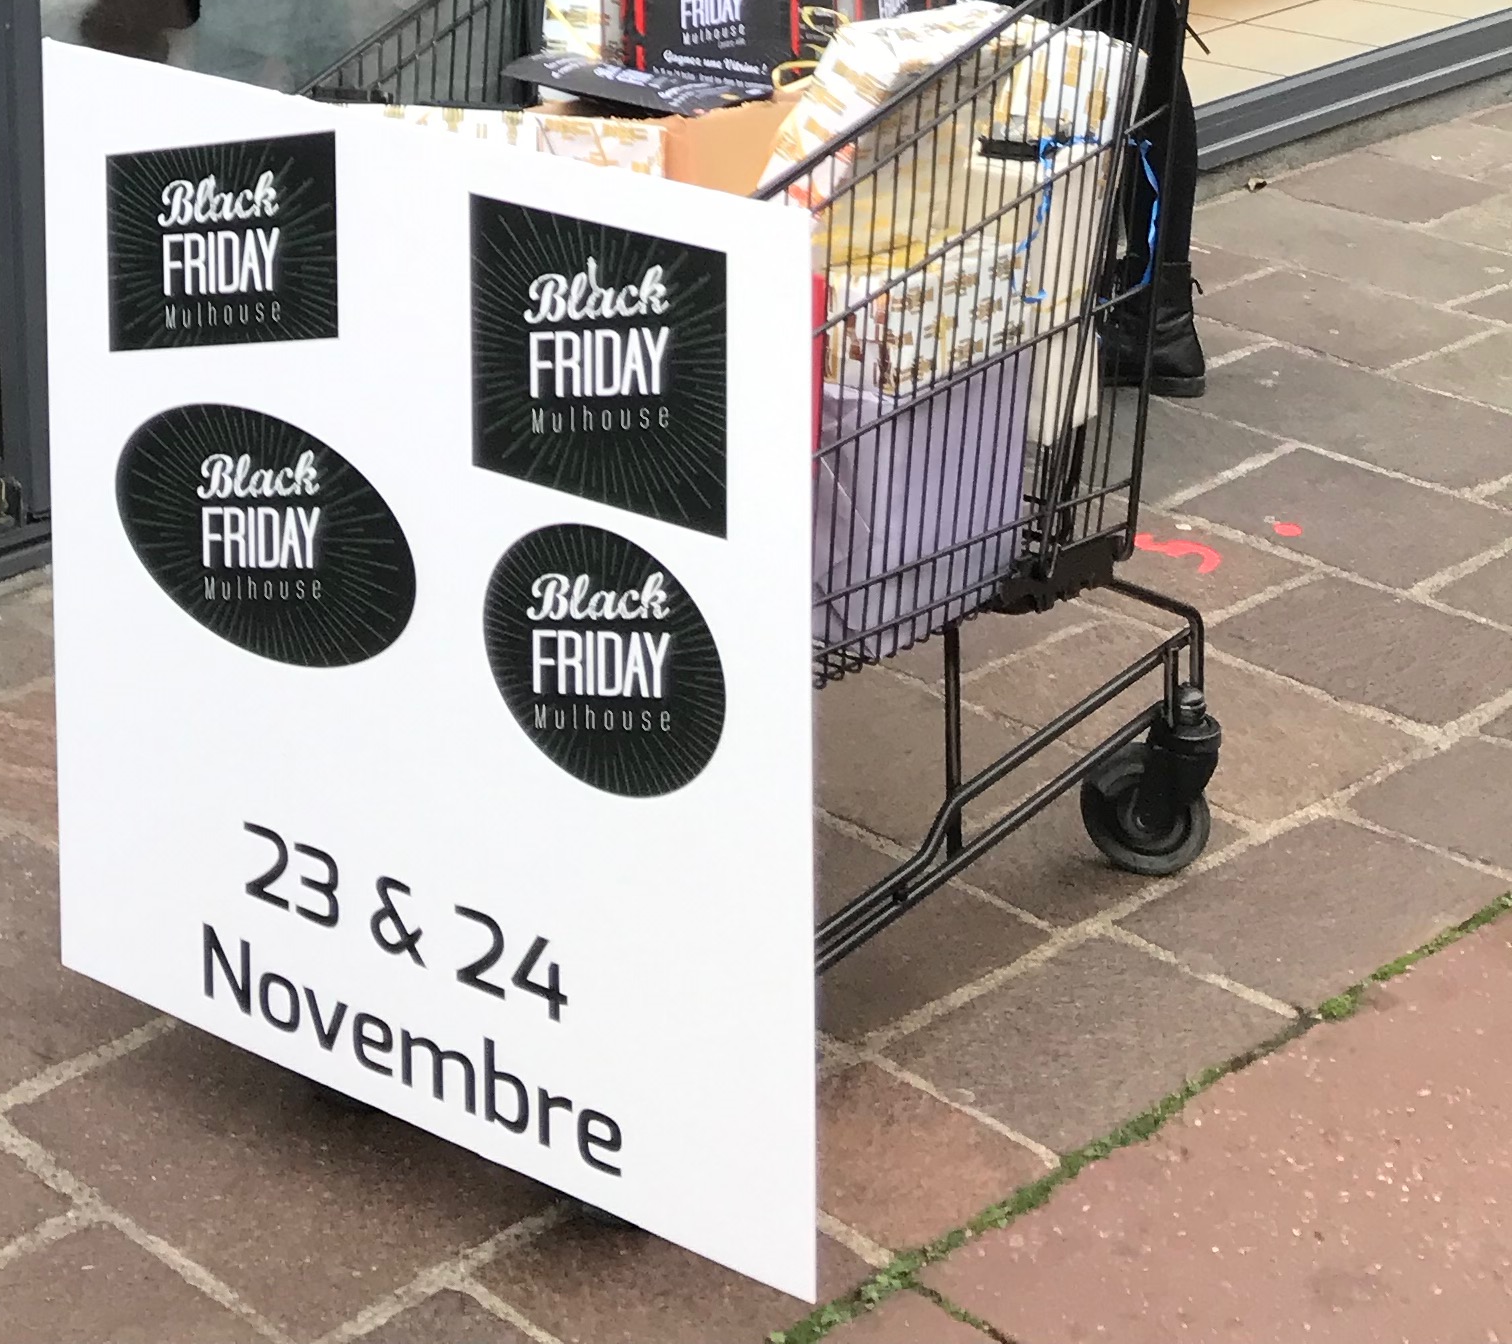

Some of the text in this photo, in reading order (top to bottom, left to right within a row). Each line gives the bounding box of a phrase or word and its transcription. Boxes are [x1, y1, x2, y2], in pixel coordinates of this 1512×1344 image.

[157, 171, 279, 226] Black
[162, 228, 280, 296] FRIDAY
[523, 259, 670, 324] Black
[165, 299, 282, 330] Mulhouse
[529, 327, 670, 398] FRIDAY
[531, 405, 670, 434] Mulhouse
[196, 450, 320, 500] Black
[201, 506, 321, 569] FRIDAY
[204, 574, 323, 601] Mulhouse
[526, 572, 671, 622] Black
[531, 630, 671, 699] FRIDAY
[534, 703, 672, 732] Mulhouse
[243, 820, 569, 1023] 23 & 24
[202, 921, 623, 1178] Novembre
